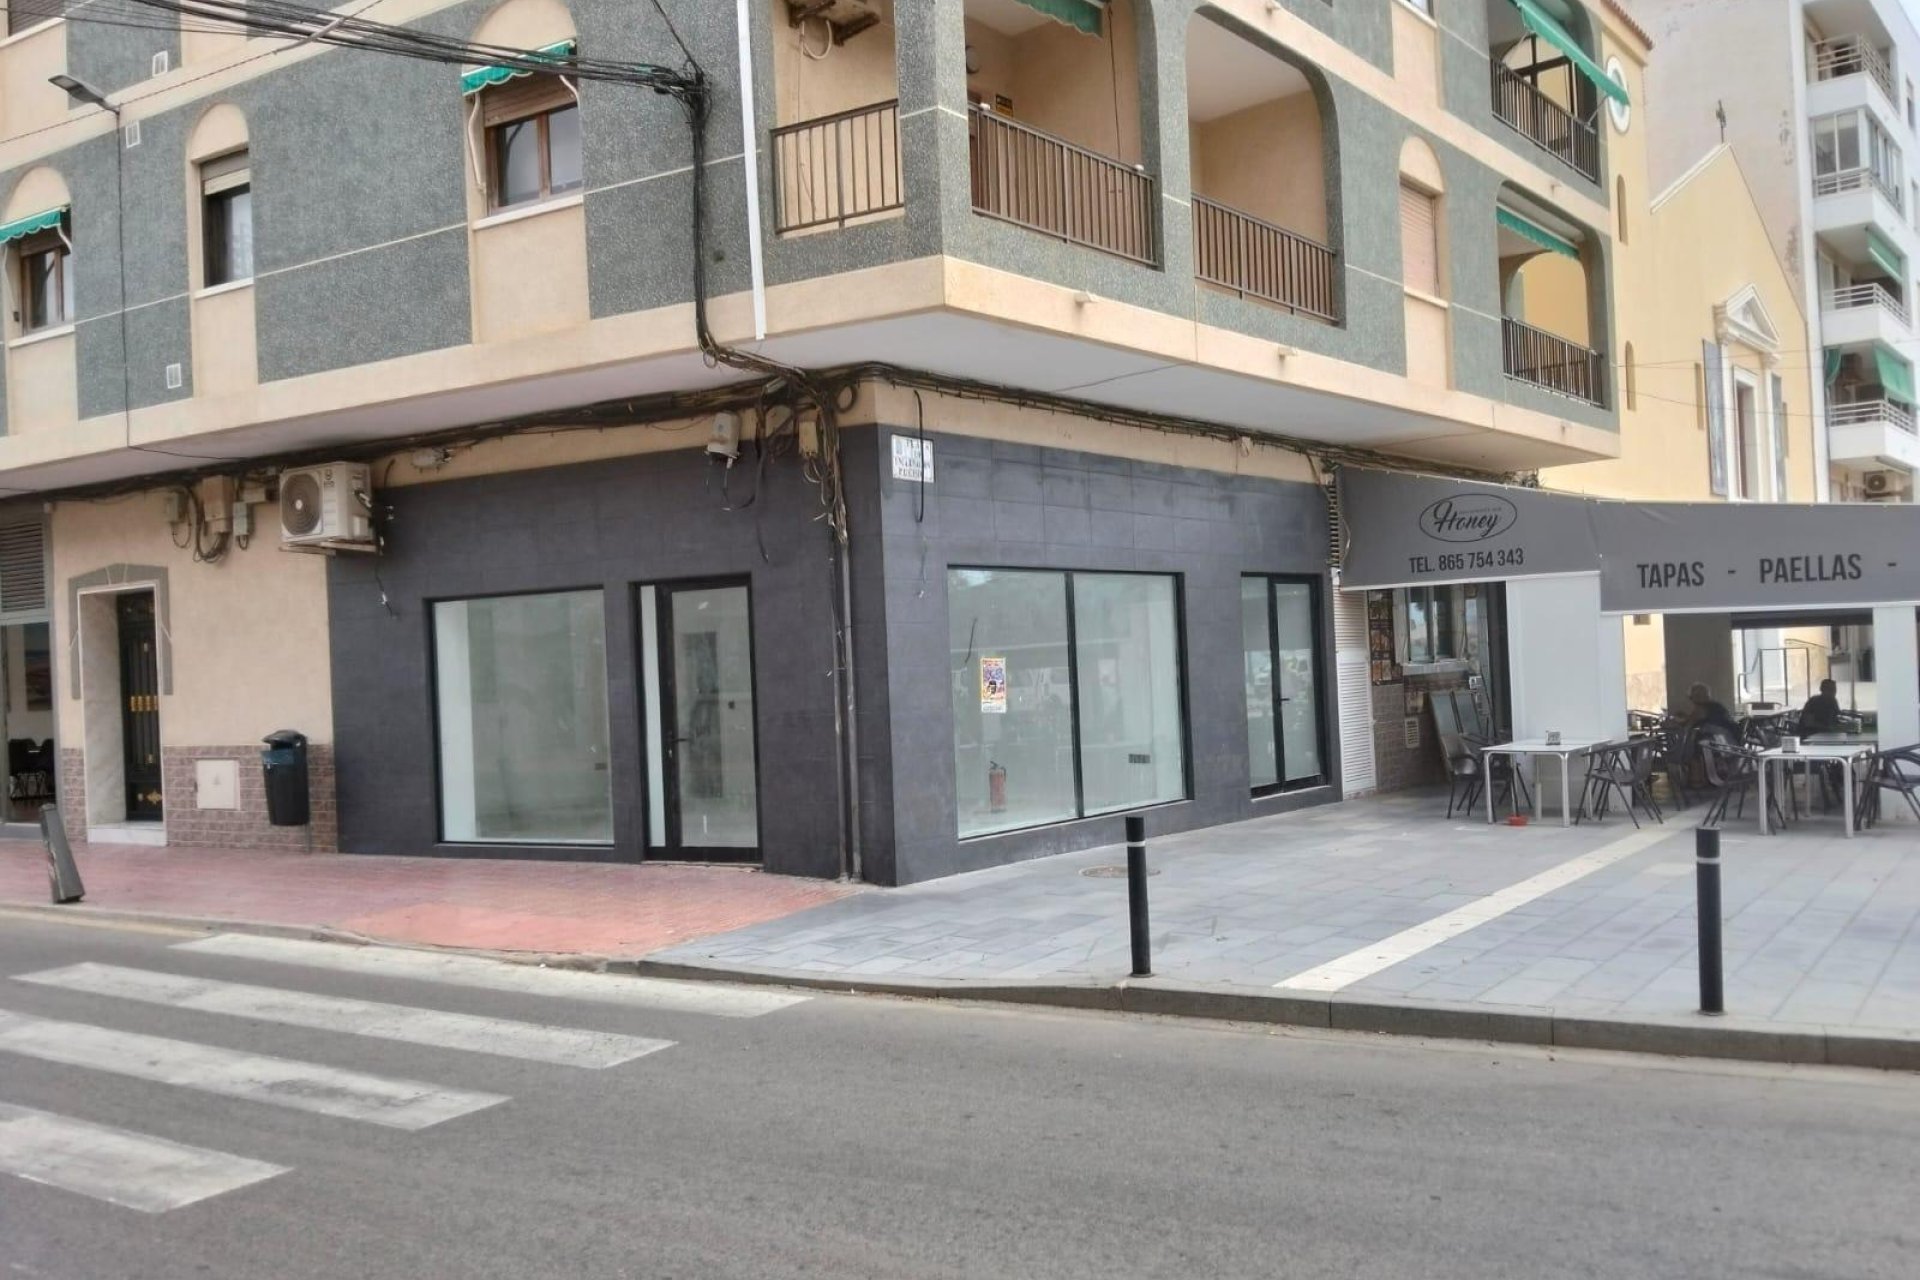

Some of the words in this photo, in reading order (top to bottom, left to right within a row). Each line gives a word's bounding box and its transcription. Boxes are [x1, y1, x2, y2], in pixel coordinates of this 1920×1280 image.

[1433, 501, 1499, 538] Honey
[1409, 556, 1436, 574] TEL.
[1439, 554, 1464, 571] 865
[1467, 551, 1494, 569] 754
[1498, 548, 1524, 566] 343
[1637, 561, 1704, 588] TAPAS
[1759, 554, 1862, 583] PAELLAS
